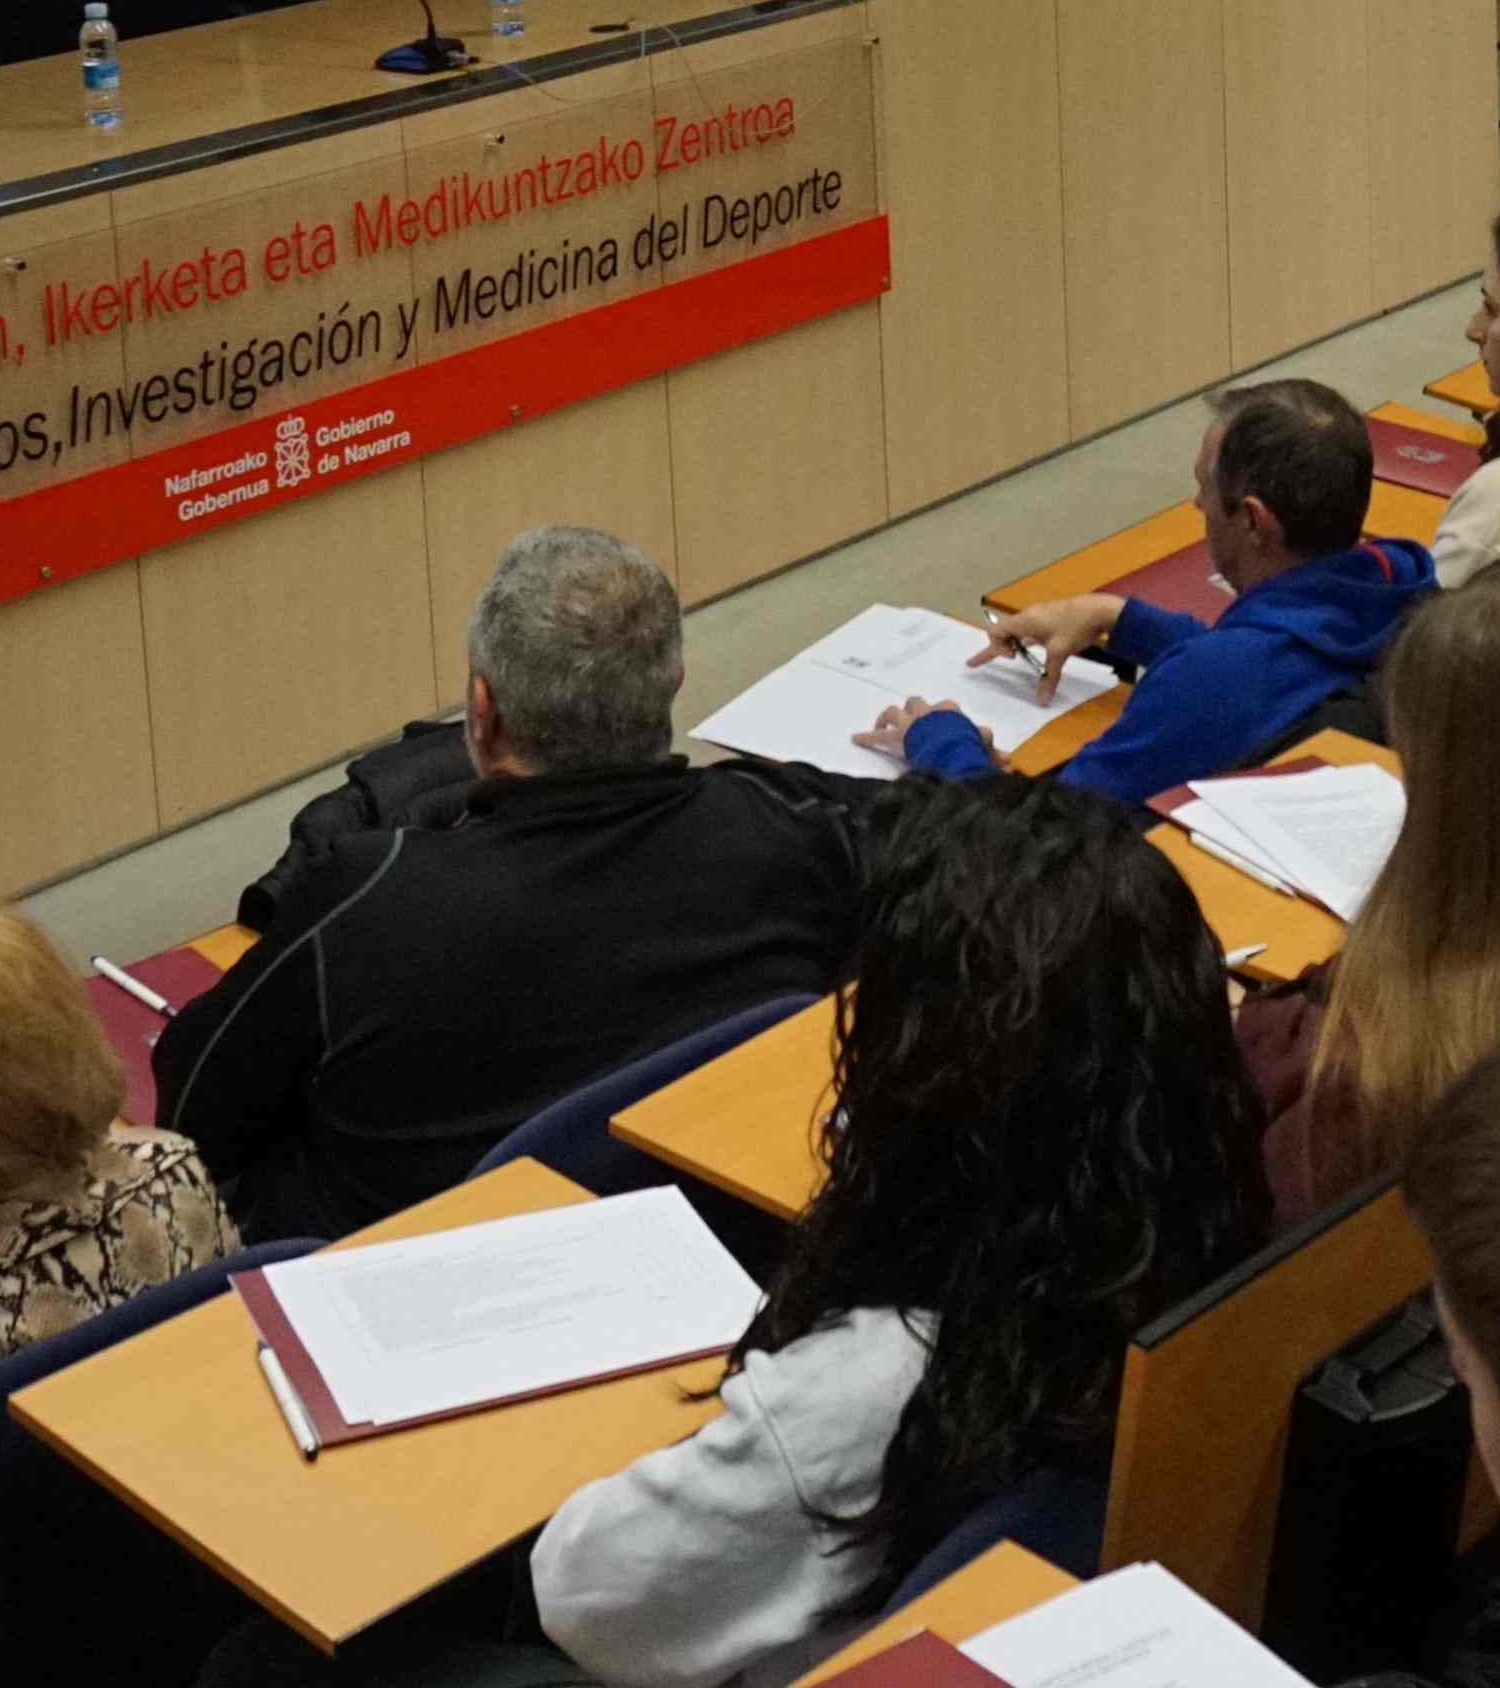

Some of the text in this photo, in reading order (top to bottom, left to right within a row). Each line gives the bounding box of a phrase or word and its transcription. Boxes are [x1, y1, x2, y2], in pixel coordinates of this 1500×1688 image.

[43, 246, 248, 346] Ikerketa
[263, 221, 337, 283] eta
[353, 135, 645, 258] Medikuntzako
[653, 97, 795, 174] Zentroa
[396, 297, 420, 361] y
[434, 237, 618, 334] Medicina
[633, 204, 689, 272] del
[702, 168, 843, 250] Deporte
[314, 408, 396, 447] Gobierno
[164, 450, 269, 498] Nafarroako
[317, 430, 412, 475] de Navarra
[177, 476, 270, 522] Gobernua
